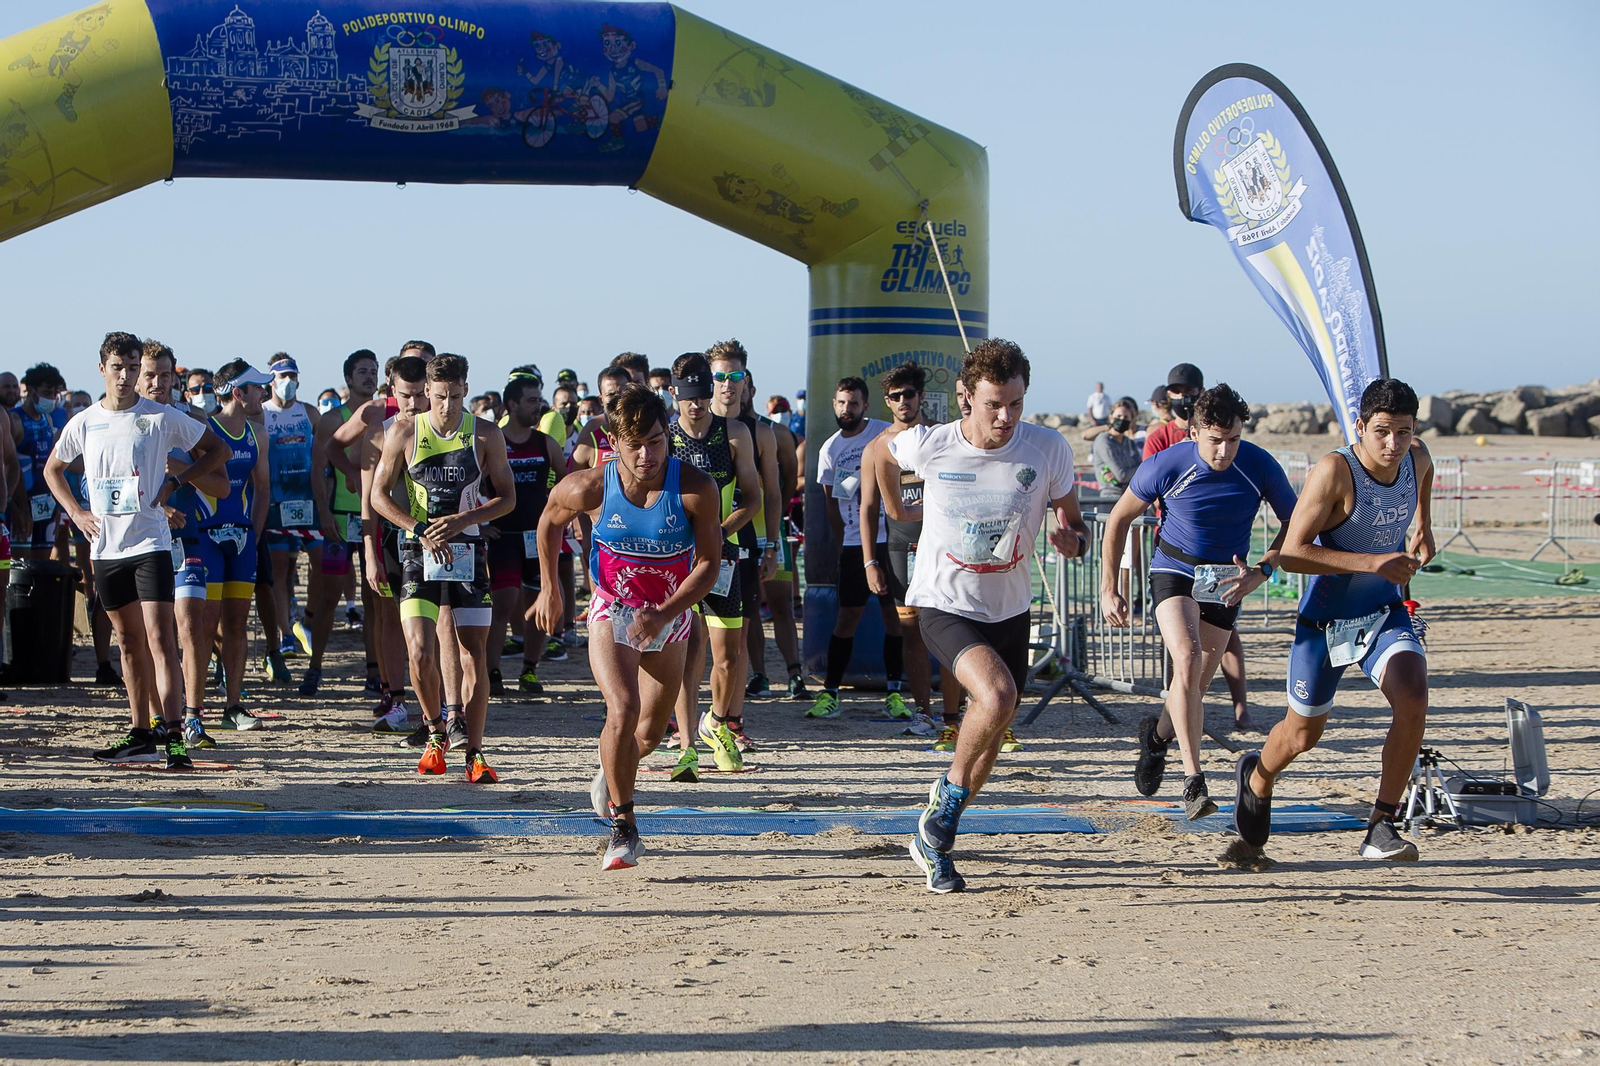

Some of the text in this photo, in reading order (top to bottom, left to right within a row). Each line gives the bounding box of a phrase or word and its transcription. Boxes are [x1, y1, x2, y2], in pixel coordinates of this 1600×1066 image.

[342, 12, 486, 40] POLIDEPORTIVO OLIMPO
[403, 107, 433, 116] CADIZ
[378, 119, 410, 131] Fundado
[416, 121, 434, 131] Abril
[436, 119, 455, 129] 1968
[895, 219, 967, 237] escuela
[880, 267, 971, 296] OLIMPO
[861, 350, 945, 380] POLIDEPORTIVO
[424, 466, 466, 482] MONTERO
[513, 471, 537, 483] ANCHEZ
[110, 490, 121, 506] 9
[36, 502, 50, 515] 34
[290, 508, 304, 520] 36
[1371, 502, 1409, 526] ADS
[978, 519, 1010, 529] ACUAT
[1370, 526, 1402, 548] PABLO
[607, 540, 683, 554] CREDUS
[1354, 628, 1368, 648] 4
